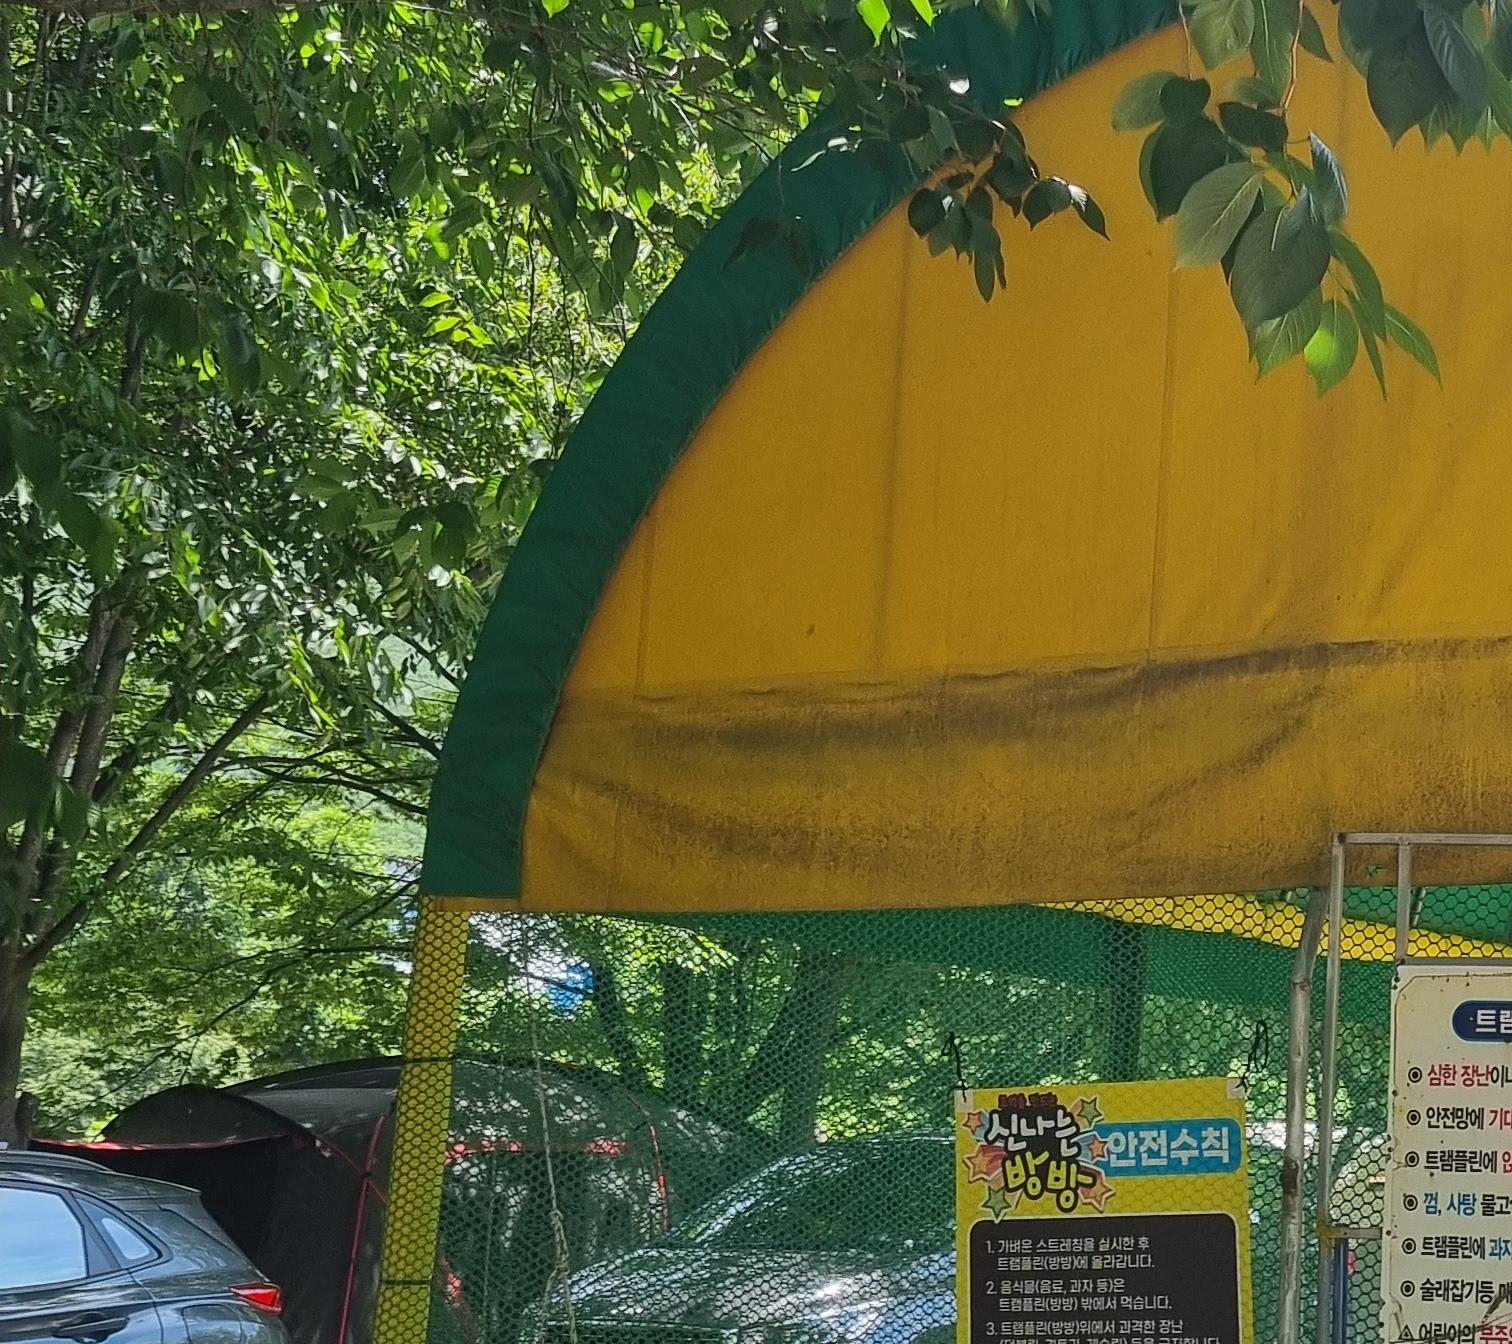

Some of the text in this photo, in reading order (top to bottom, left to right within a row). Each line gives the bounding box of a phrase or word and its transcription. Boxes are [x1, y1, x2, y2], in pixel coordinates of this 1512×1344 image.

[1427, 1064, 1457, 1087] 심한
[1426, 1107, 1484, 1130] 안전망에
[987, 1109, 1078, 1156] 신나는
[1109, 1128, 1229, 1167] 안전수칙
[1424, 1150, 1497, 1174] 트램플린에
[1005, 1151, 1094, 1208] 방방
[1423, 1192, 1441, 1216] 껌,
[1447, 1193, 1476, 1216] 사탕
[1480, 1194, 1510, 1217] 물고
[986, 1240, 995, 1253] 1.
[1036, 1238, 1095, 1254] 스트레칭을
[1099, 1237, 1135, 1252] 실시한
[1137, 1236, 1150, 1250] 후
[1421, 1236, 1485, 1259] 트램플린에
[986, 1281, 998, 1294] 2.
[1070, 1278, 1093, 1293] 과자
[1097, 1277, 1125, 1293] 등)은
[1420, 1279, 1494, 1304] 술래잡기등
[1081, 1296, 1117, 1311] 밖에서
[1120, 1295, 1172, 1310] 먹습니다.
[986, 1322, 998, 1336] 3.
[1119, 1320, 1156, 1334] 과격한
[1159, 1319, 1184, 1334] 장난
